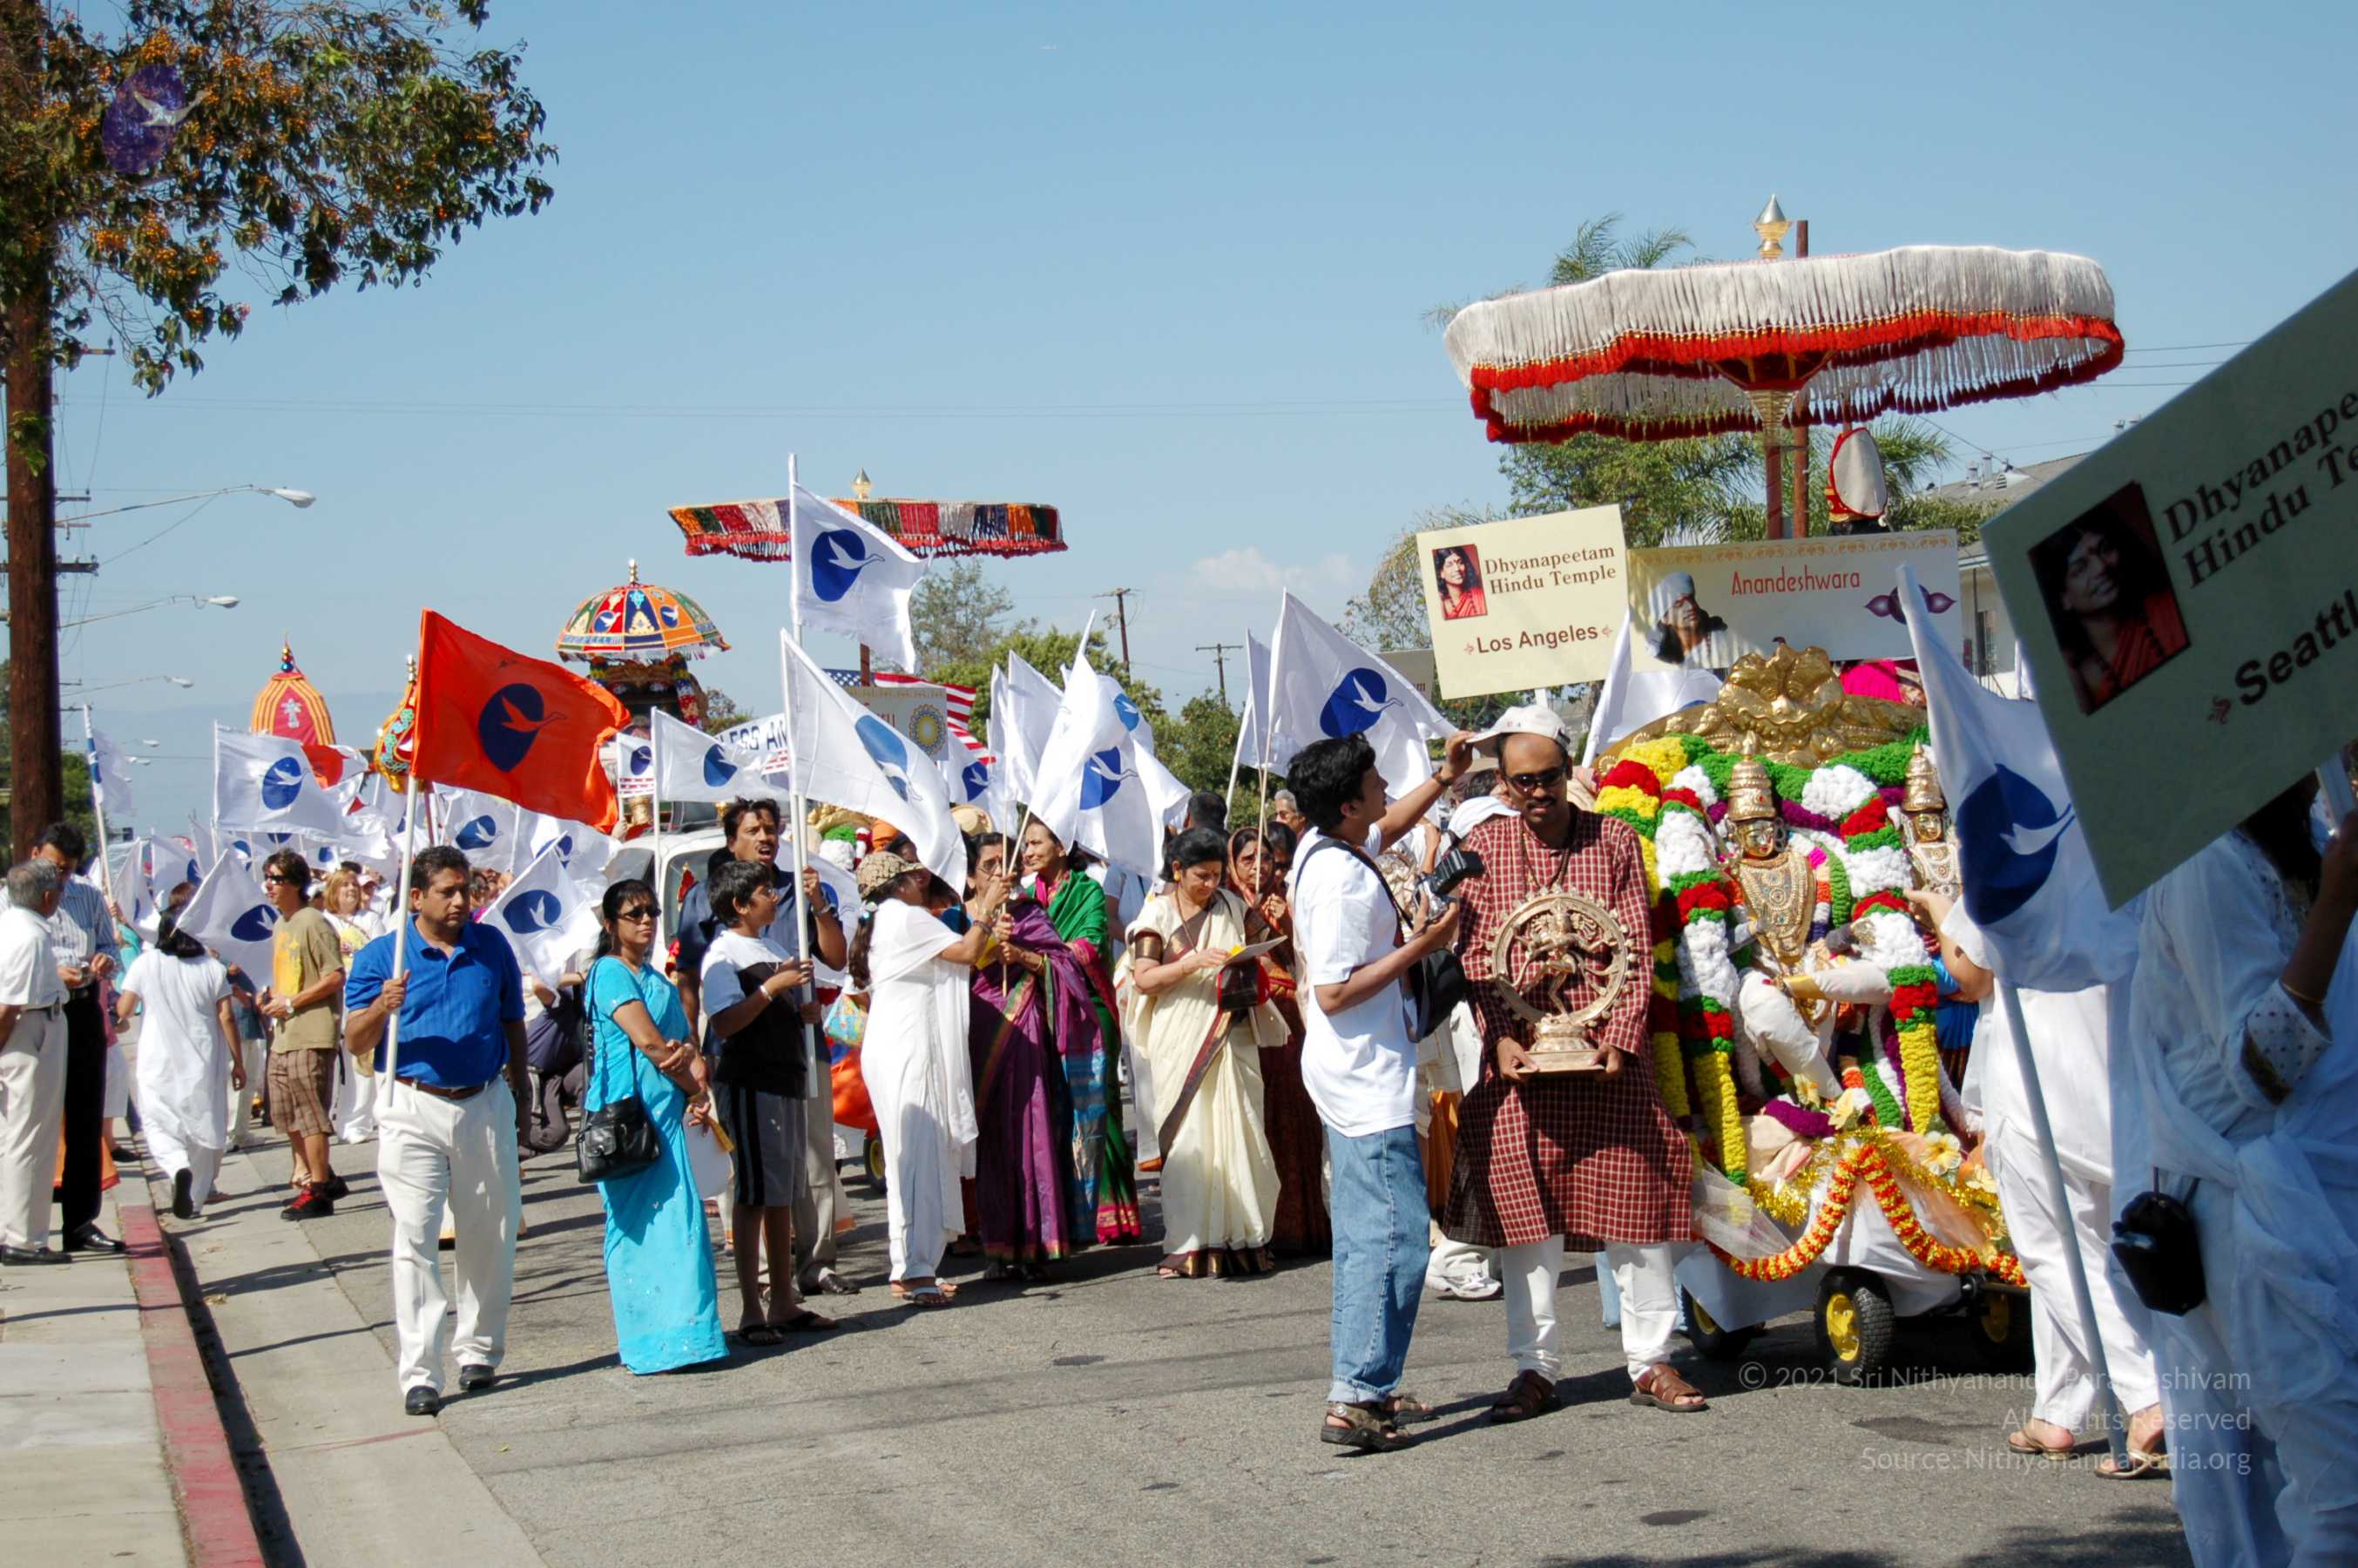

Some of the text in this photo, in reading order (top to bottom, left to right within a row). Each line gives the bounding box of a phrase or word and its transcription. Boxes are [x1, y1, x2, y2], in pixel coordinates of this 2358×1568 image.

[2181, 484, 2312, 590] Hindu
[1484, 545, 1616, 575] Dhyanapeetam
[1490, 564, 1618, 595] Hindu Temple
[1731, 564, 1861, 596] Anandeshwara
[1476, 625, 1599, 653] Los Angeles
